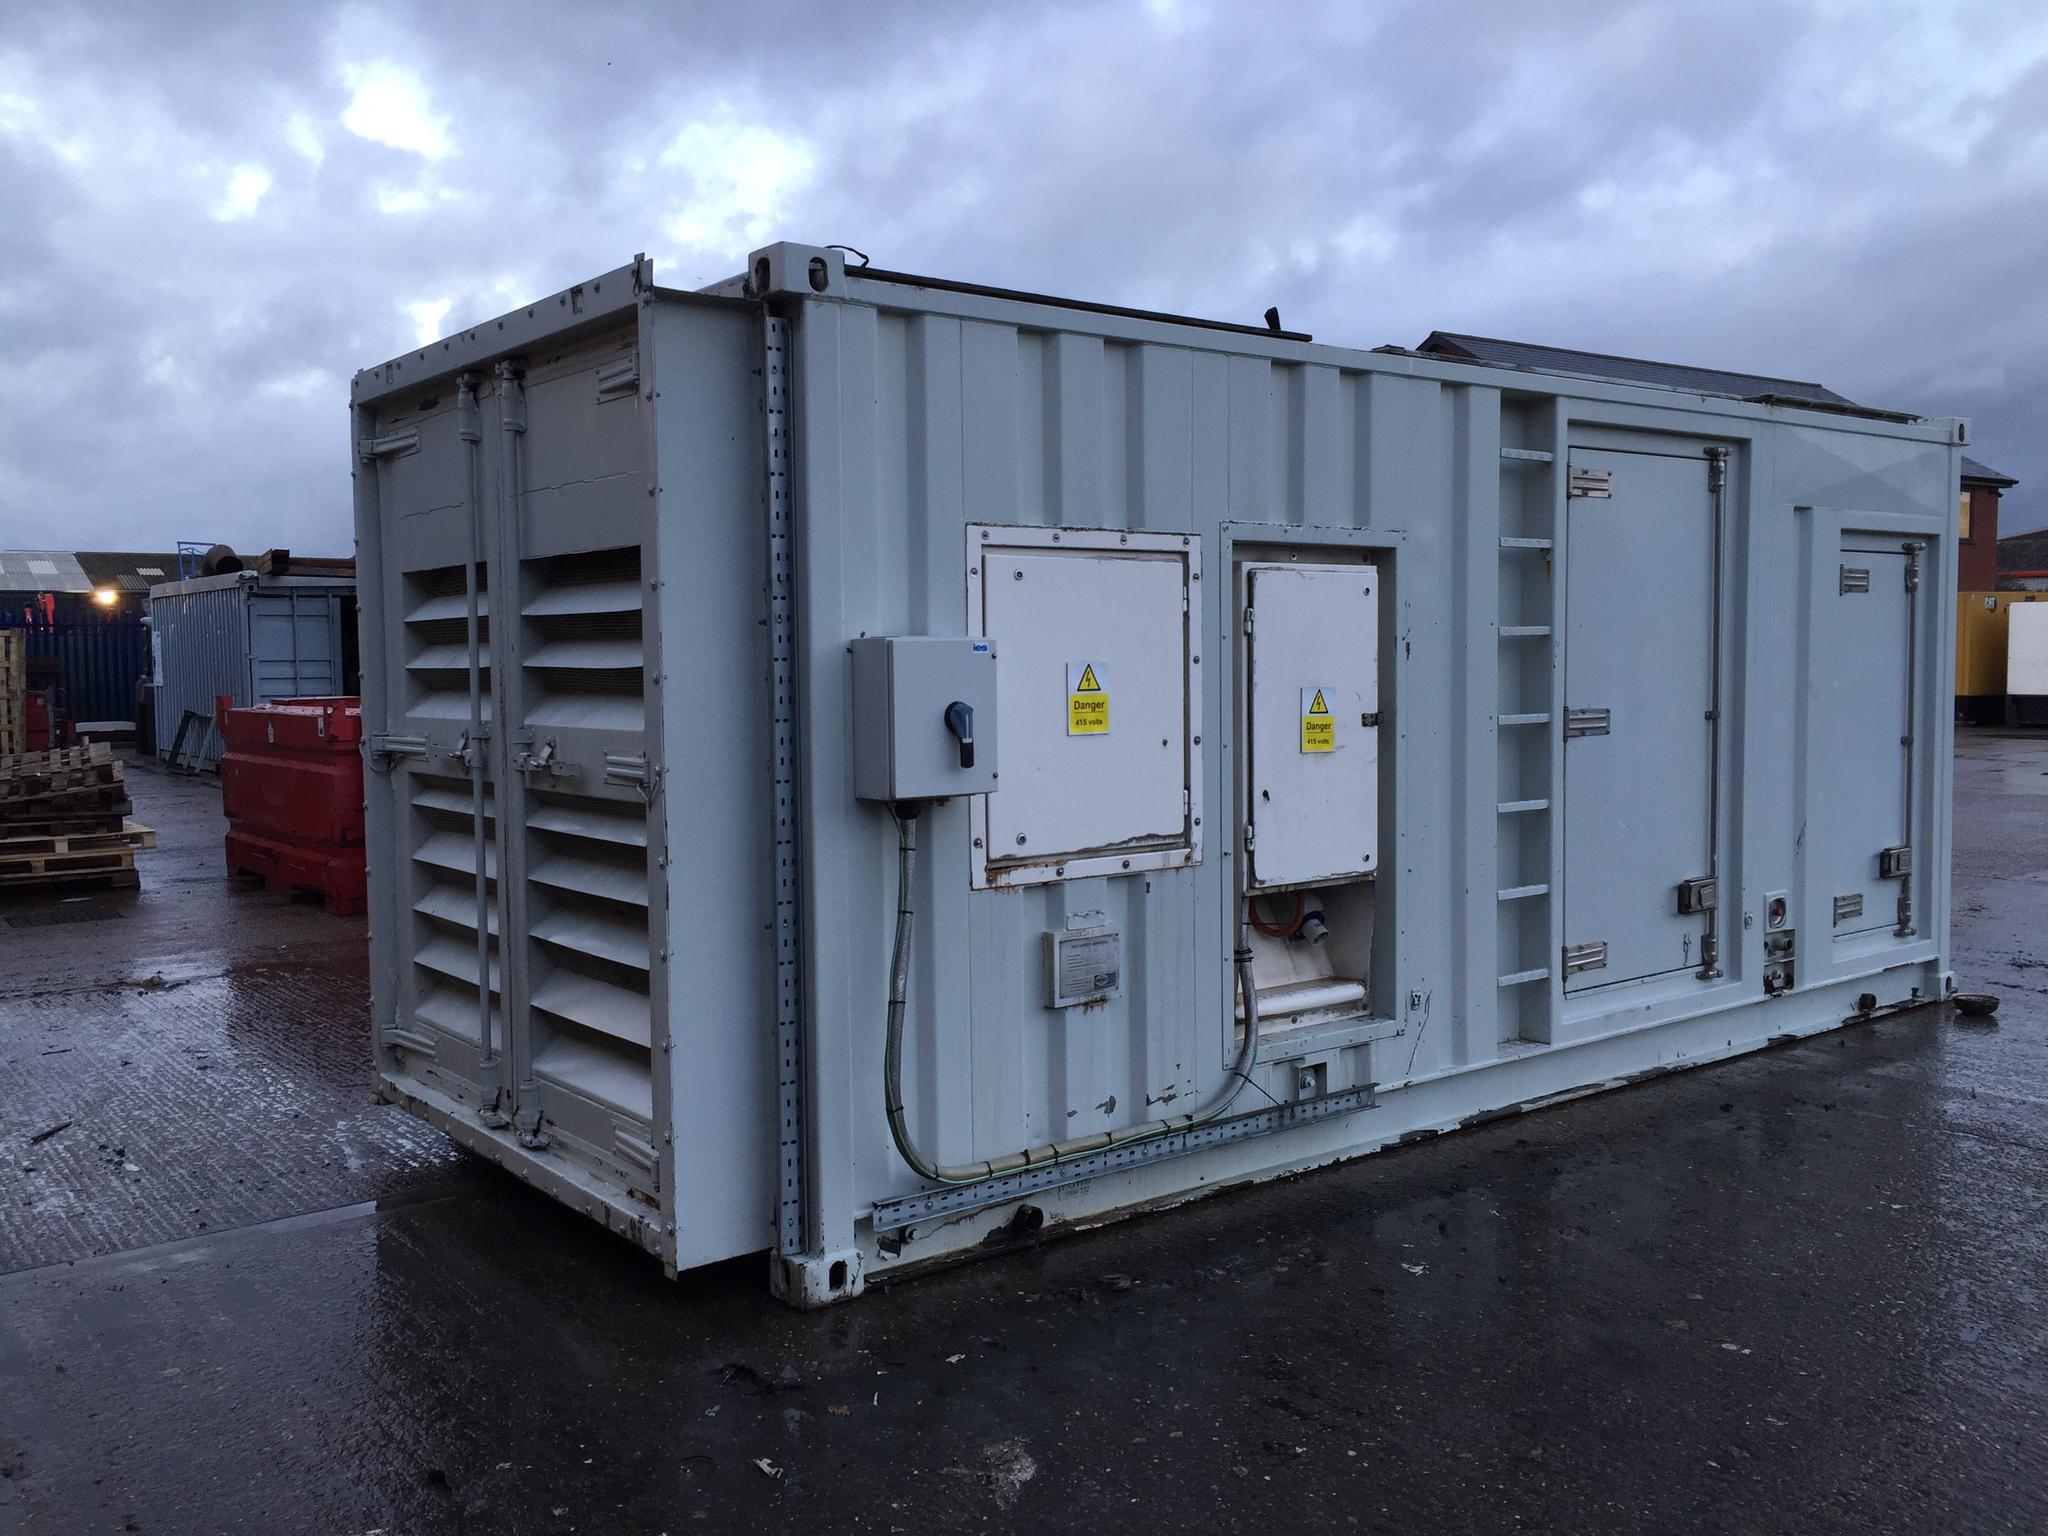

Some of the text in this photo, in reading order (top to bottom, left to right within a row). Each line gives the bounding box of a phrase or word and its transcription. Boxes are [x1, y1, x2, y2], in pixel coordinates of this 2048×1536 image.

[1074, 700, 1105, 712] Danger
[1075, 718, 1103, 726] 415 volts
[1306, 721, 1332, 732] Danger
